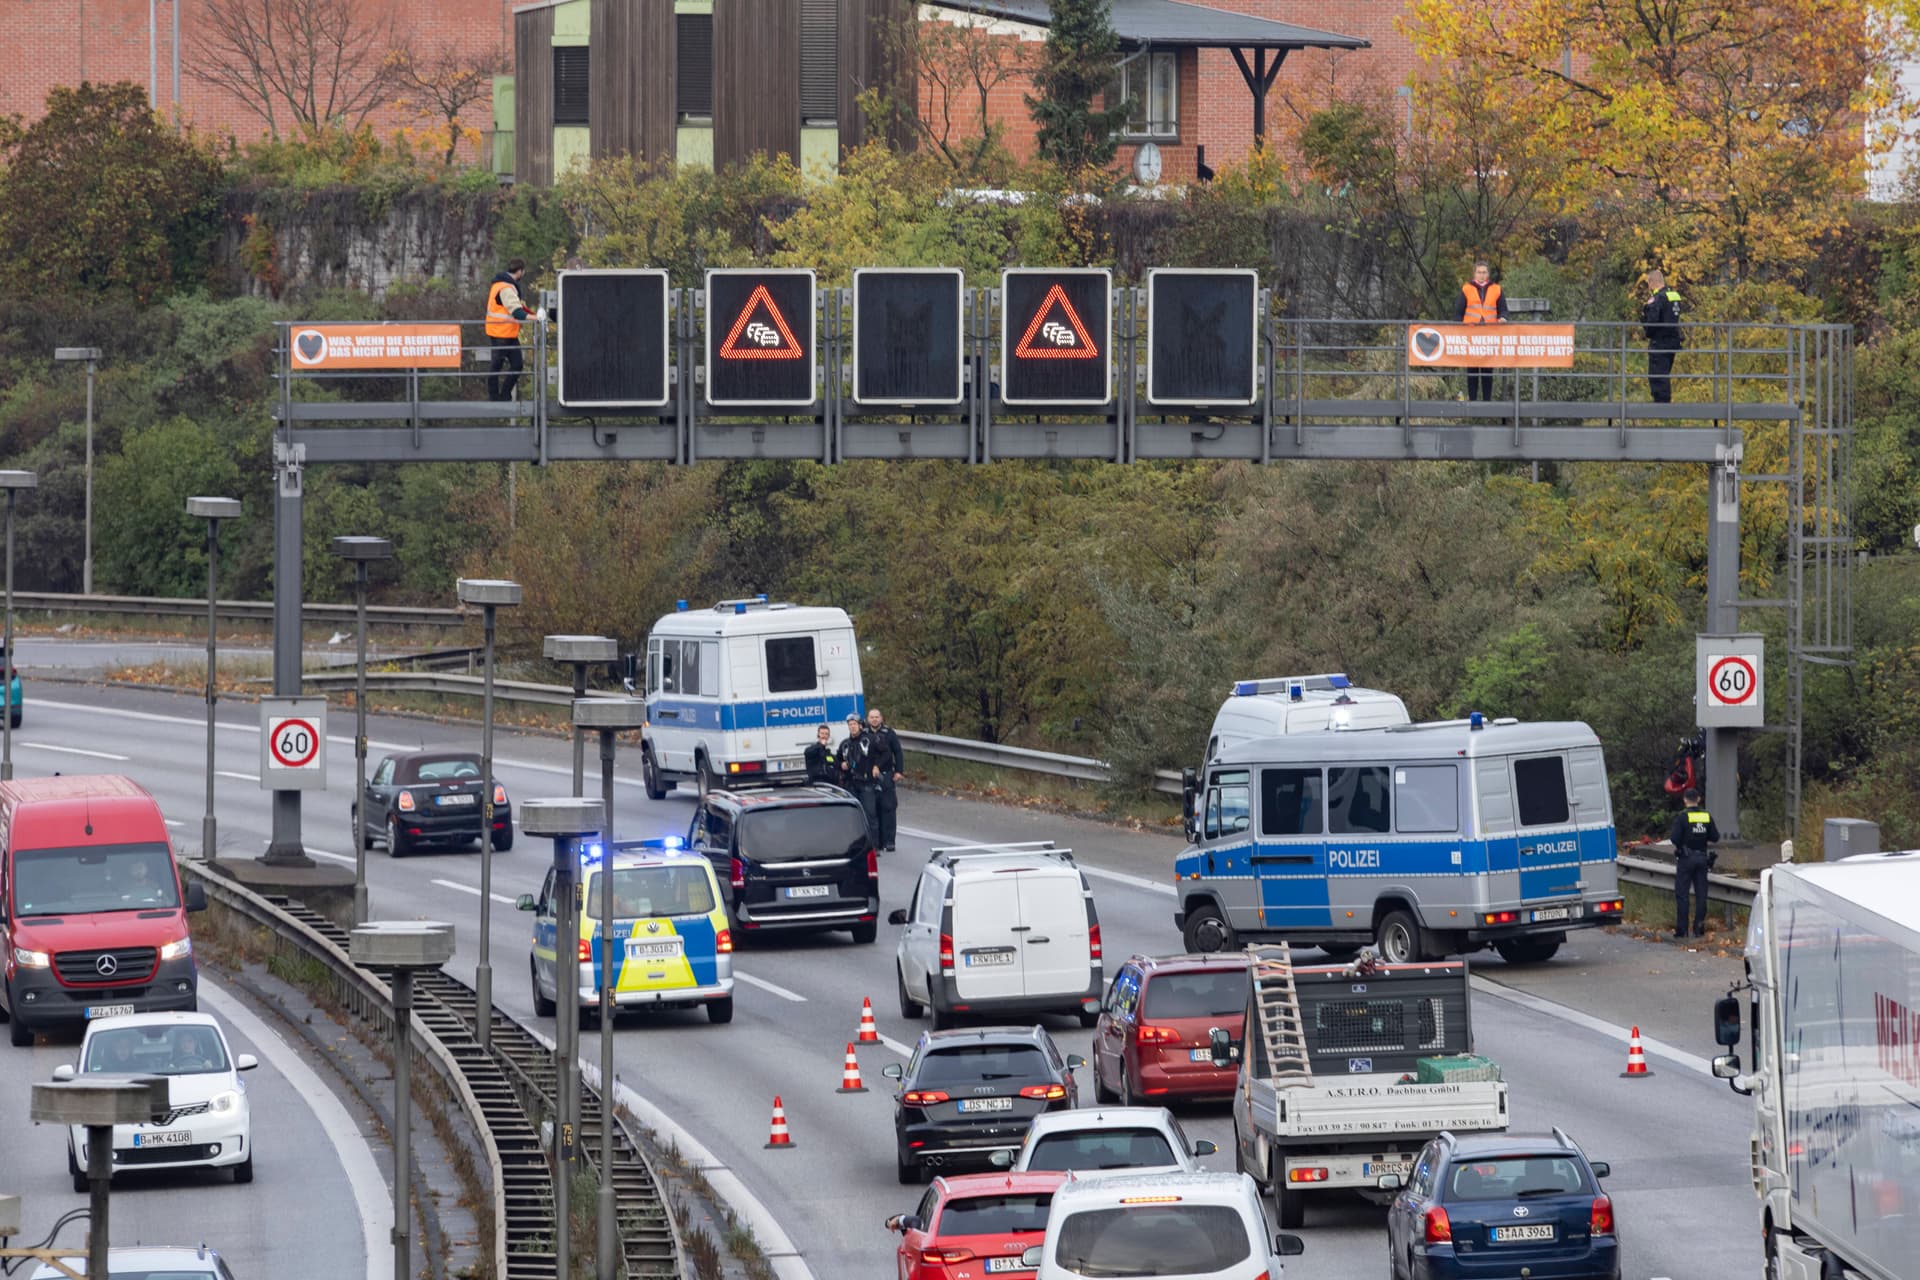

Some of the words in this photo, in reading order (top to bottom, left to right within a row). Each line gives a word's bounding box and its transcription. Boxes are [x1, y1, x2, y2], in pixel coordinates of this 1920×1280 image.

[356, 335, 385, 346] WENN
[387, 335, 403, 346] DIE
[404, 335, 459, 346] REGIERUNG
[1472, 335, 1501, 345] WENN
[1502, 335, 1518, 345] DIE
[1519, 335, 1573, 345] REGIERUNG
[328, 347, 349, 357] DAS
[353, 347, 384, 357] NICHT
[386, 347, 400, 357] IM
[402, 346, 431, 357] GRIFF
[433, 346, 459, 357] HAT?
[1446, 345, 1465, 356] DAS
[1469, 345, 1500, 356] NICHT
[1502, 345, 1515, 356] IM
[1517, 345, 1545, 356] GRIFF
[1547, 345, 1574, 356] HAT?
[1719, 669, 1745, 691] 60
[782, 705, 825, 718] POLIZEI
[281, 732, 308, 754] 60
[1536, 840, 1577, 855] POLIZEI
[1328, 850, 1381, 868] POLIZEI
[1386, 1086, 1427, 1096] Dachbau
[562, 1124, 573, 1135] 75
[140, 1135, 146, 1145] B
[152, 1134, 165, 1144] MK
[562, 1135, 573, 1146] 15
[1370, 1162, 1386, 1174] OPR
[1391, 1162, 1402, 1173] CS
[1497, 1230, 1504, 1240] B
[1511, 1229, 1524, 1239] AA
[1527, 1226, 1552, 1238] 3961
[994, 1259, 1002, 1270] B
